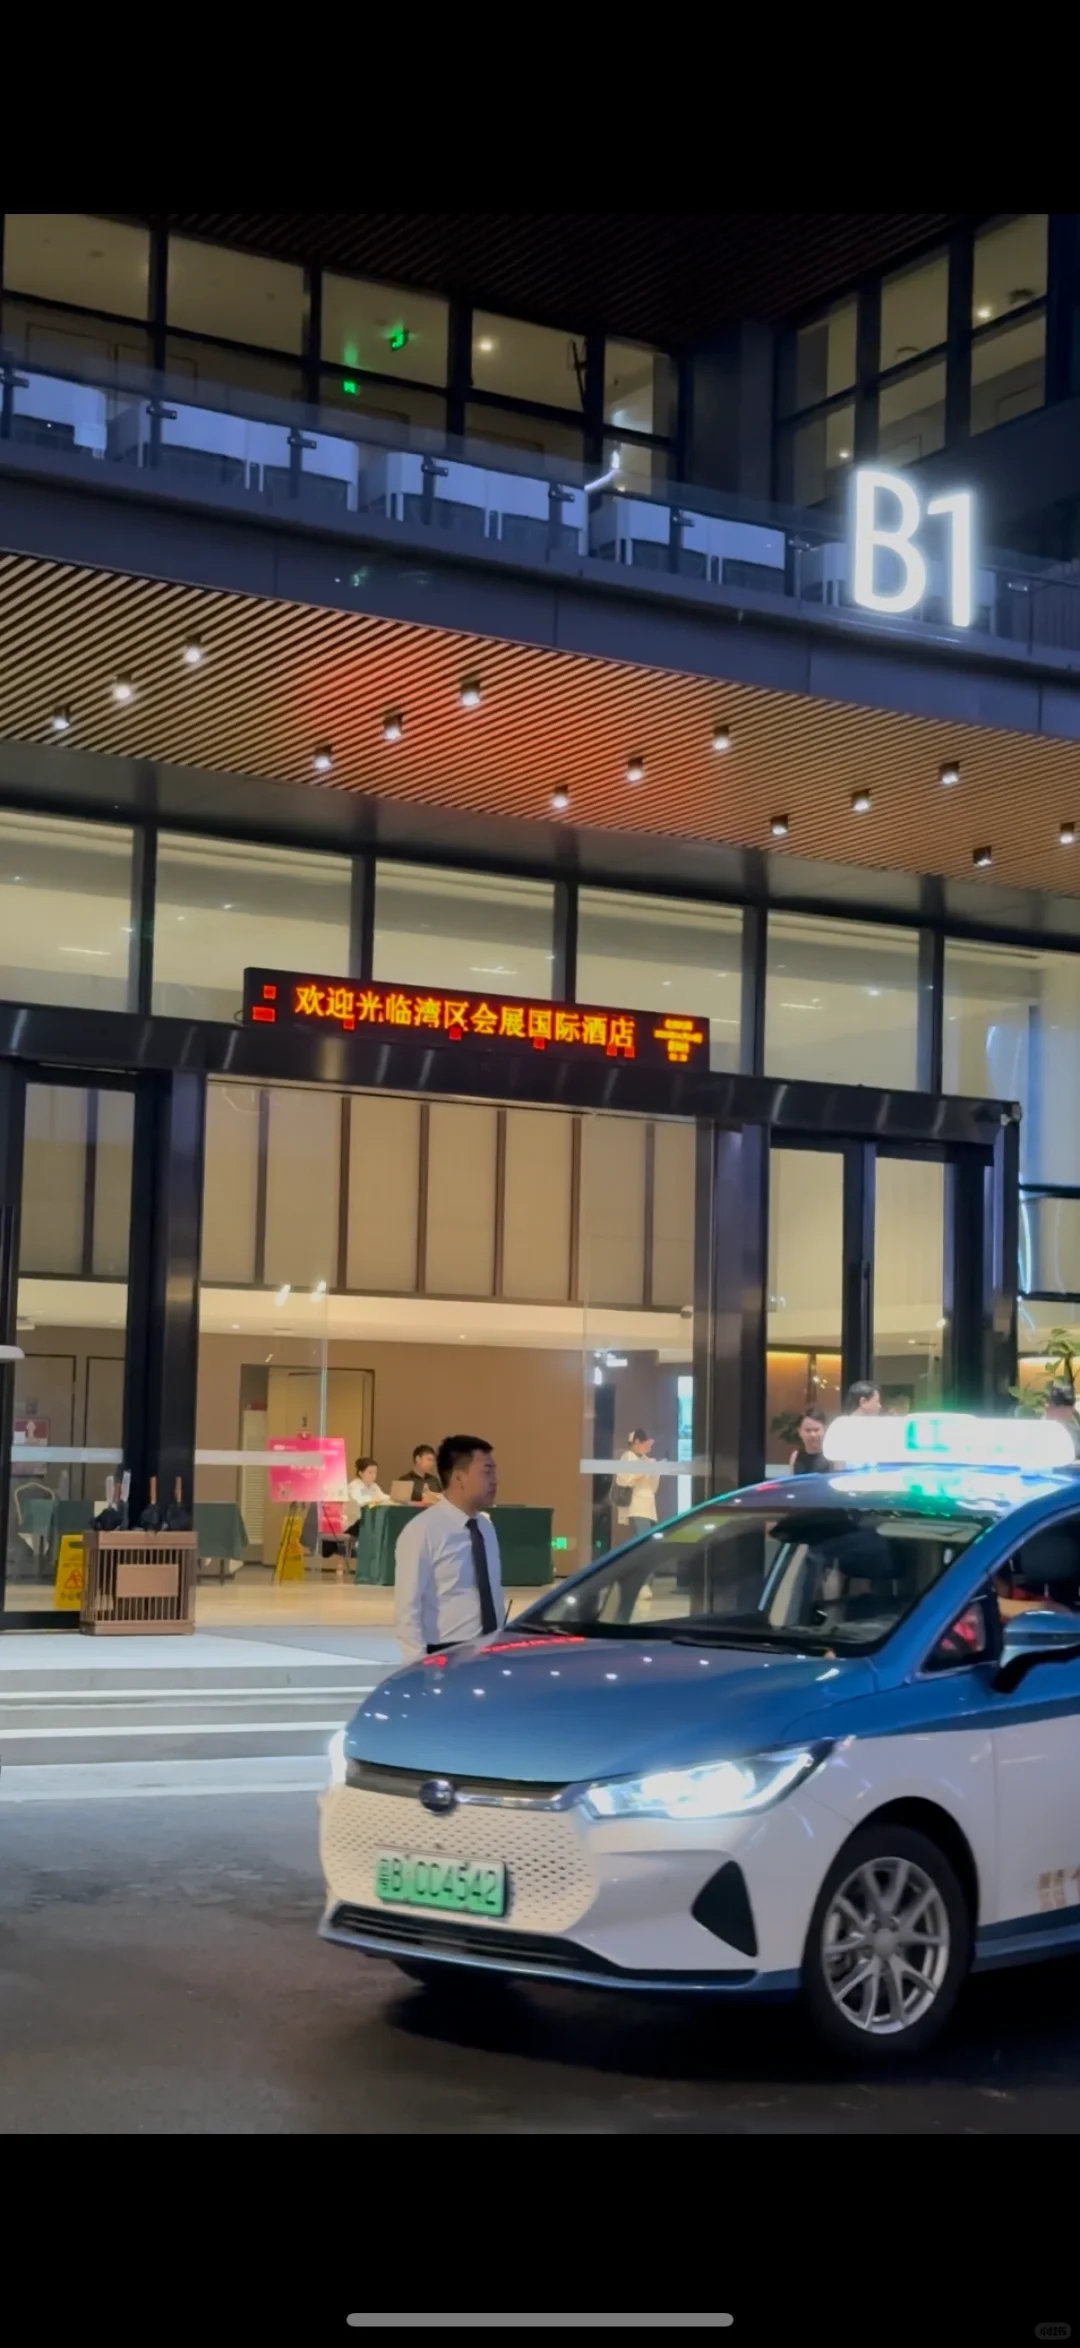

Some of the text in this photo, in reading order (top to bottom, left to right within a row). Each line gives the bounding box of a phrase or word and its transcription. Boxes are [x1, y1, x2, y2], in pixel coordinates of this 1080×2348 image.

[855, 470, 970, 627] B1
[294, 984, 636, 1048] 欢迎光临湾区会展国际酒店
